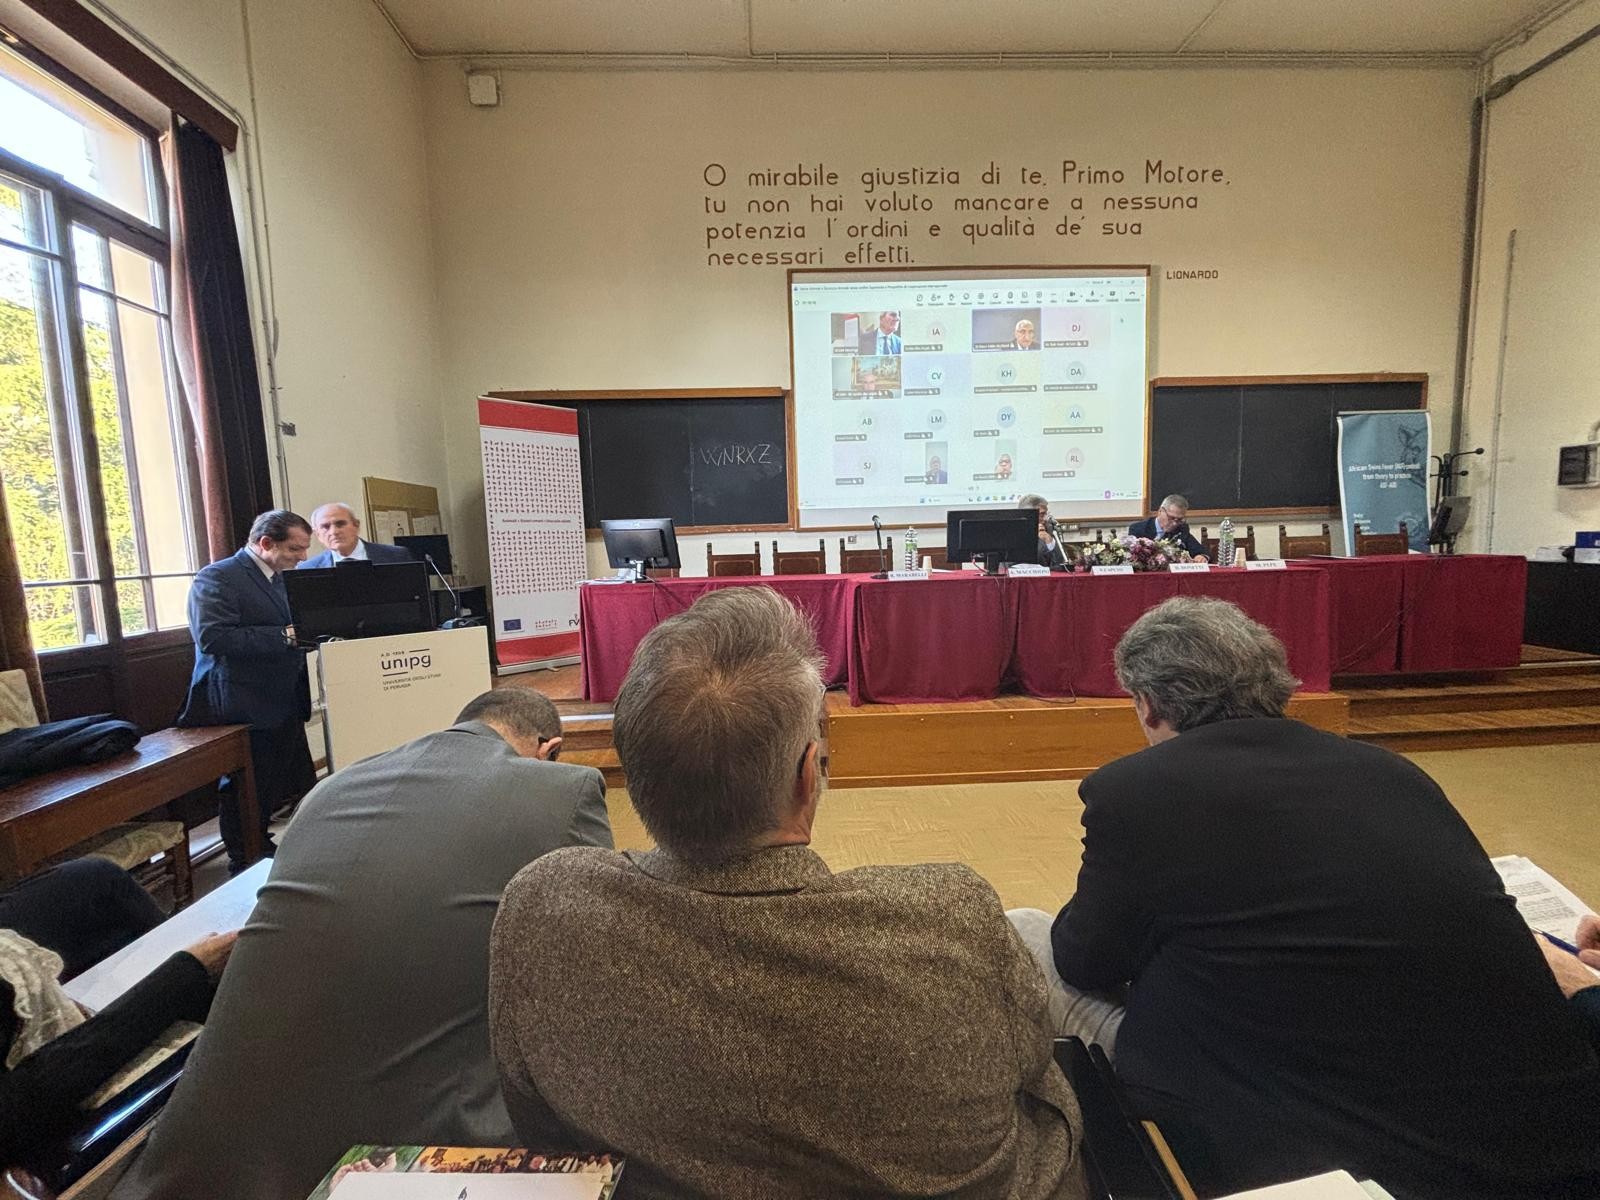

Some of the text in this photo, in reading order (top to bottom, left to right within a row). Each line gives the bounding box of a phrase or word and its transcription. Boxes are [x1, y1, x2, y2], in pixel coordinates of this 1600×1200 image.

[704, 164, 726, 186] O
[749, 164, 838, 186] mirabile
[861, 167, 959, 193] giustizia
[982, 161, 1000, 184] di
[1063, 160, 1124, 184] Primo
[705, 191, 1197, 213] tu non hai voluto mancare a nessuna
[707, 222, 805, 249] potenzia
[929, 225, 940, 237] e
[963, 215, 1034, 245] qualità
[1102, 223, 1141, 235] sua
[708, 242, 914, 266] necessari effetti.
[1001, 370, 1012, 378] KH
[1070, 368, 1082, 376] DA
[931, 416, 942, 424] LM
[381, 654, 431, 670] unipg
